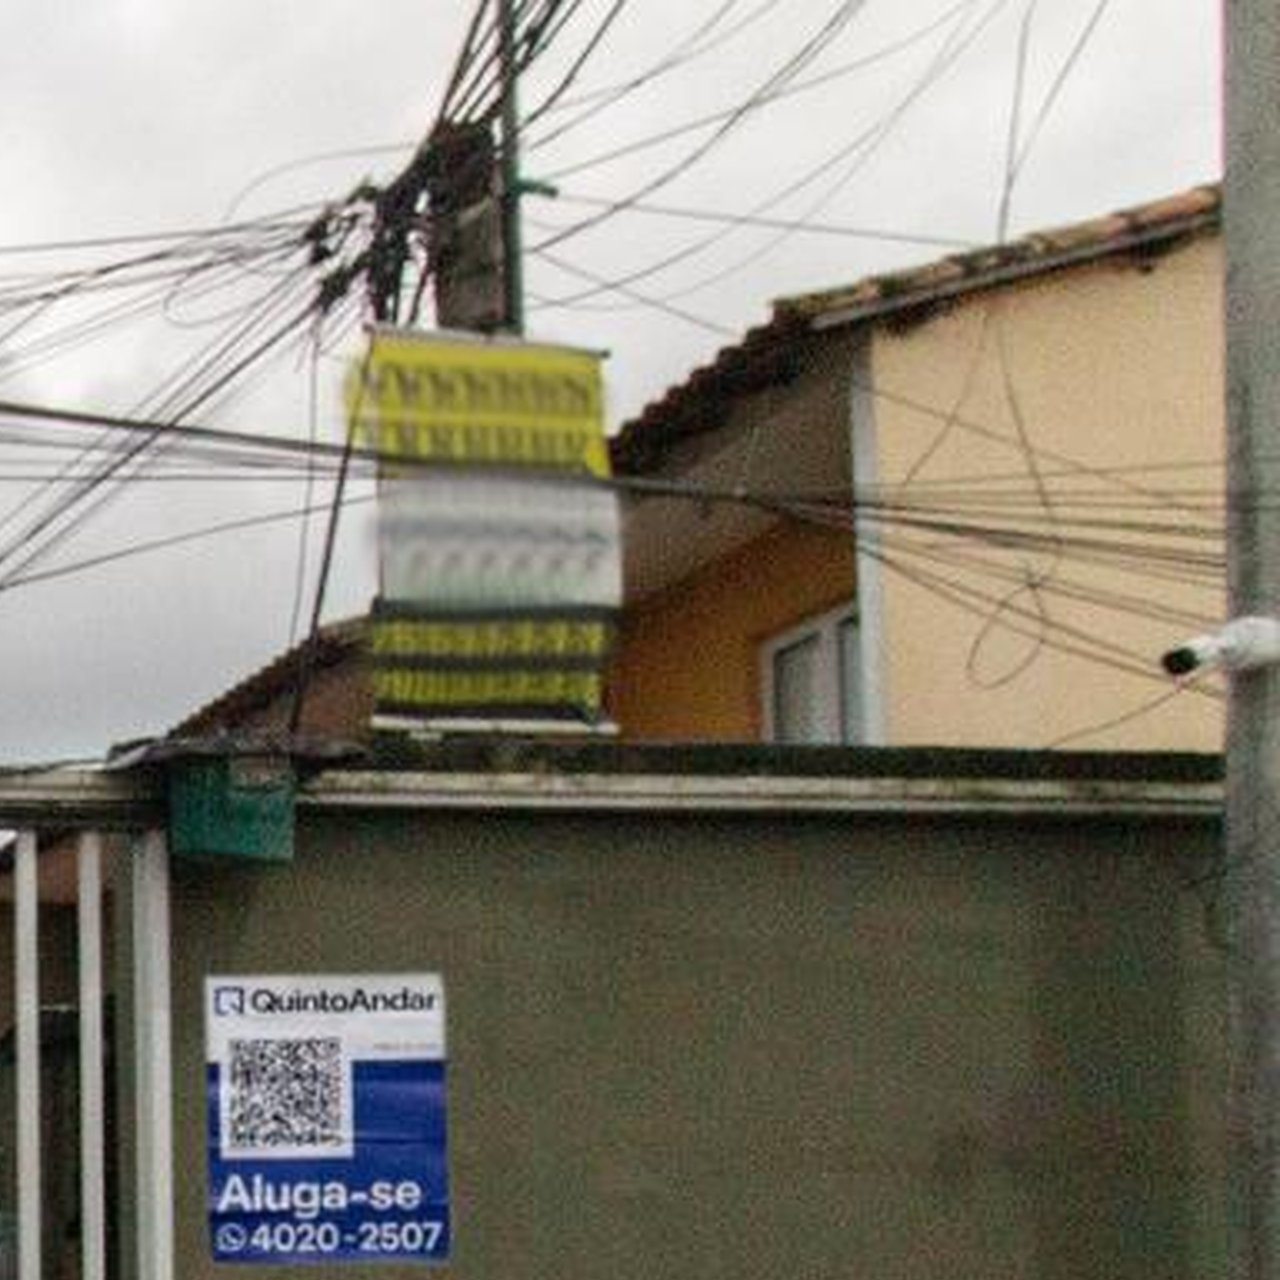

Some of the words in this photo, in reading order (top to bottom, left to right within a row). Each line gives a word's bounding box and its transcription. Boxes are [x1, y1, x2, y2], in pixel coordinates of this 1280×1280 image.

[251, 988, 436, 1014] QuintoAndar
[217, 1173, 422, 1218] Aluga-se
[250, 1222, 442, 1252] 4020-2507
